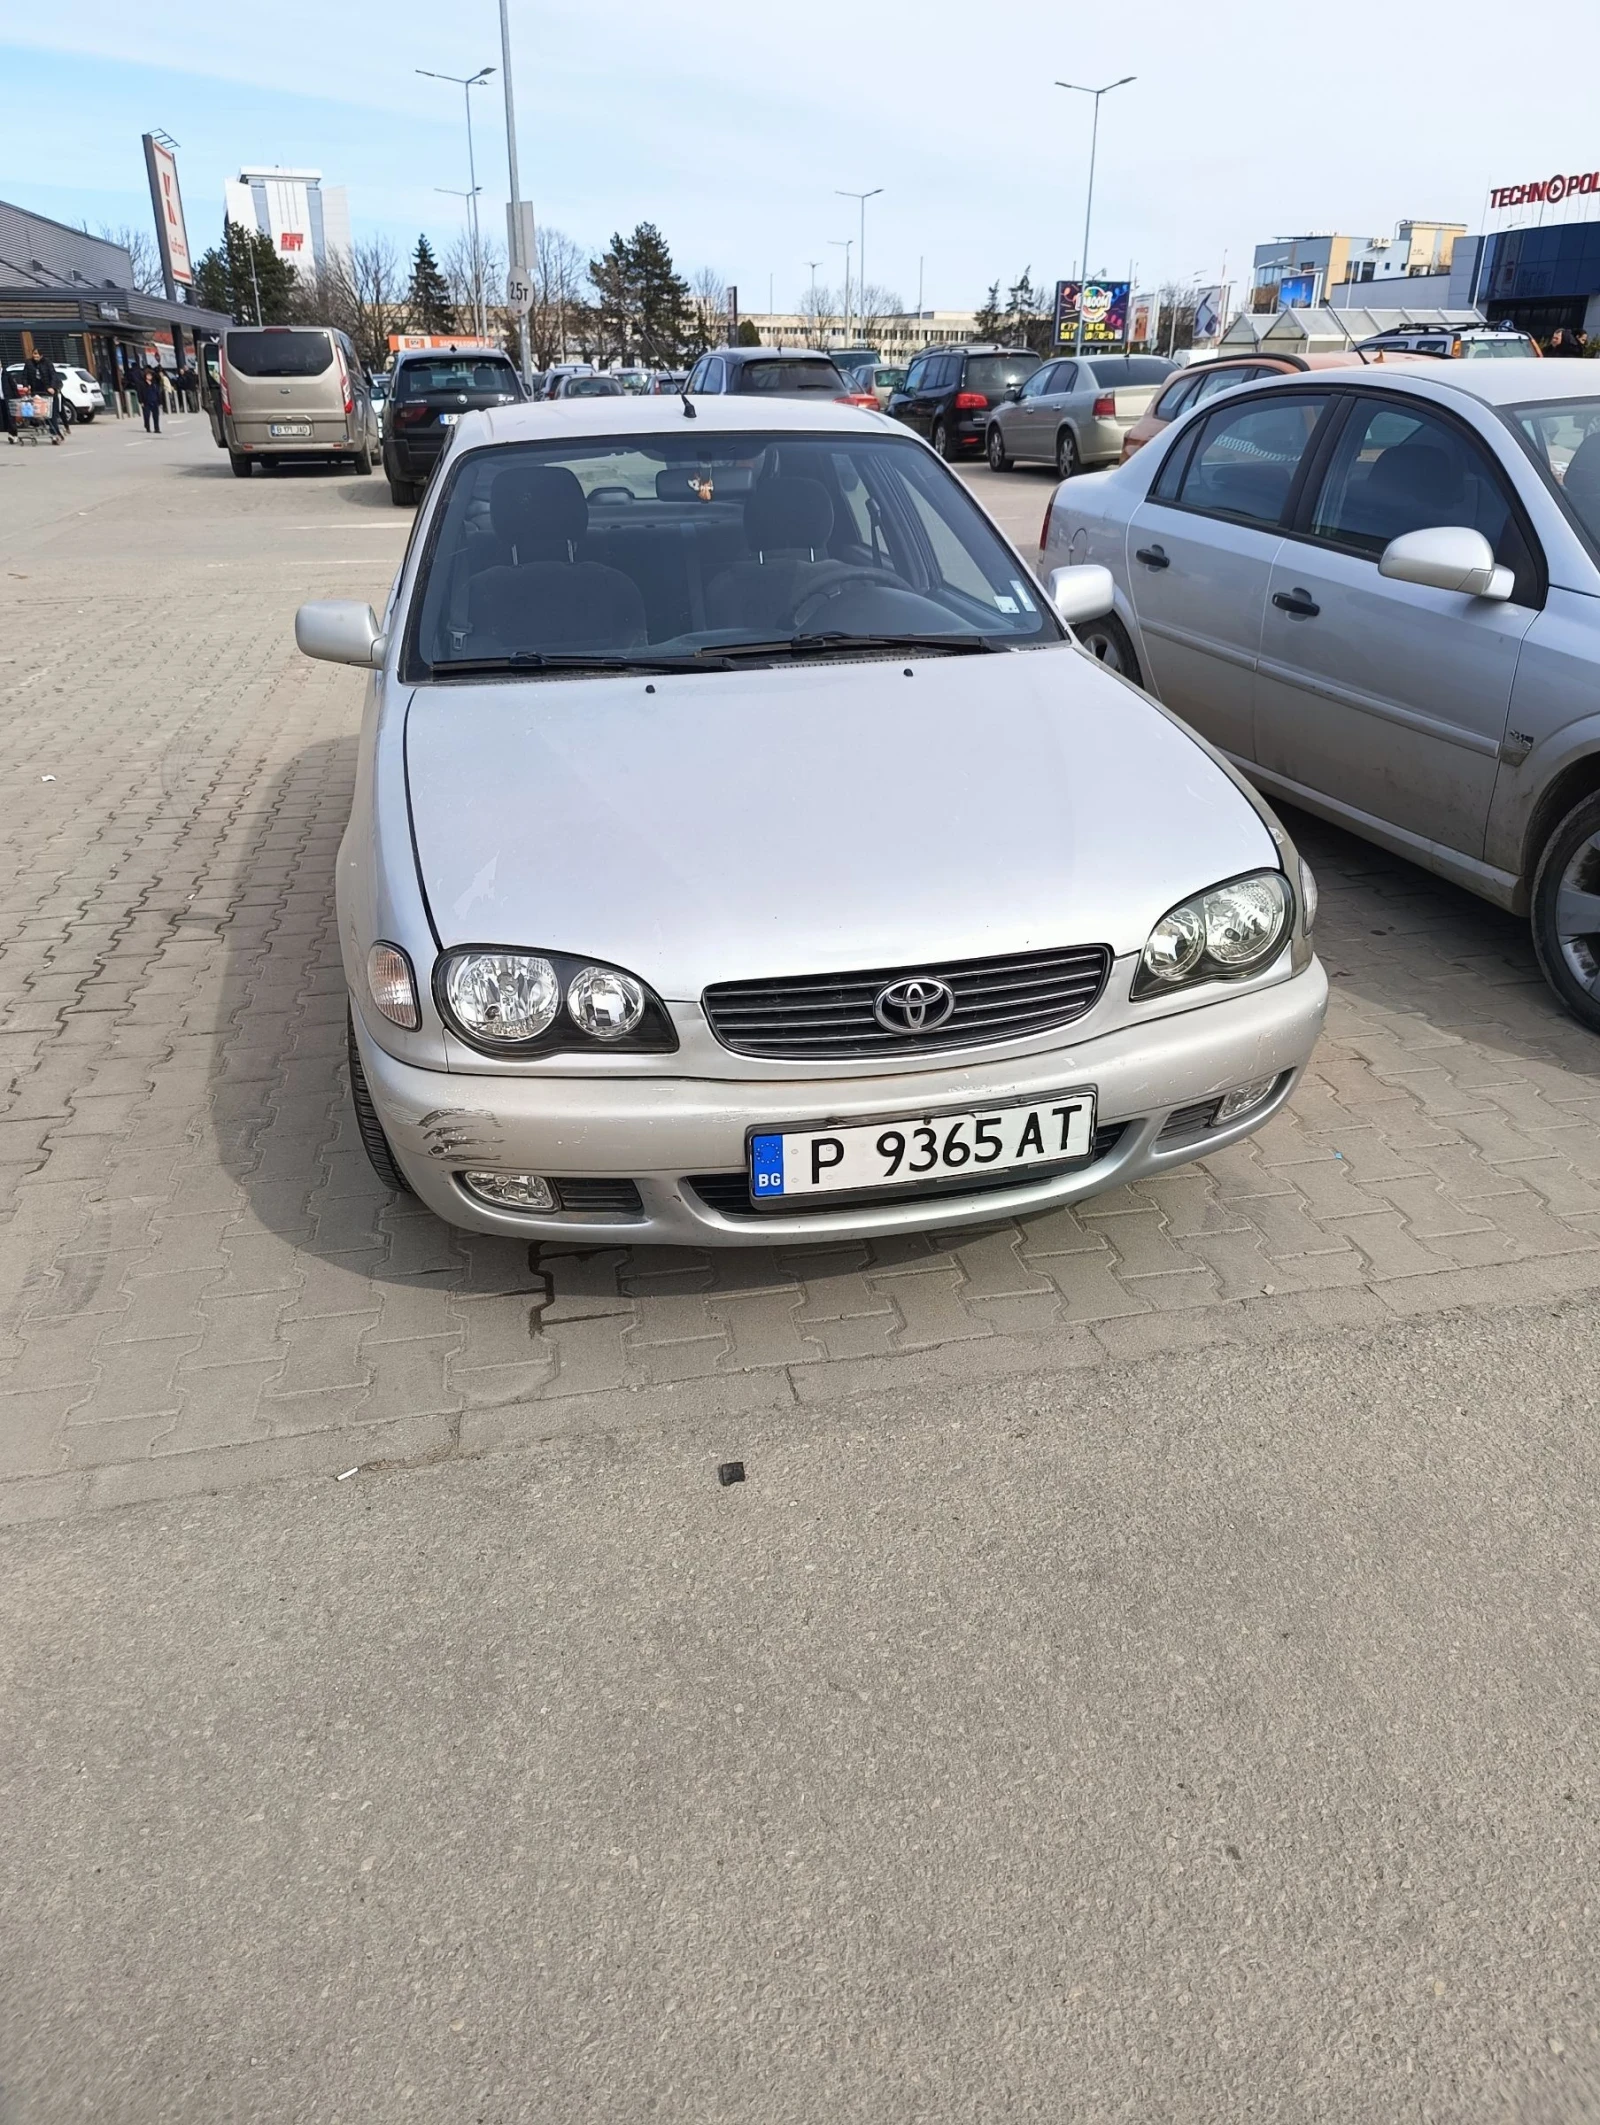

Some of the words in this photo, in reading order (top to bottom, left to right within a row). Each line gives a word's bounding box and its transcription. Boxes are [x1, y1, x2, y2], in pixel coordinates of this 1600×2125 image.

[810, 1137, 845, 1184] P
[875, 1117, 1004, 1178] 9365
[1015, 1104, 1083, 1158] AT
[758, 1173, 781, 1188] BG
